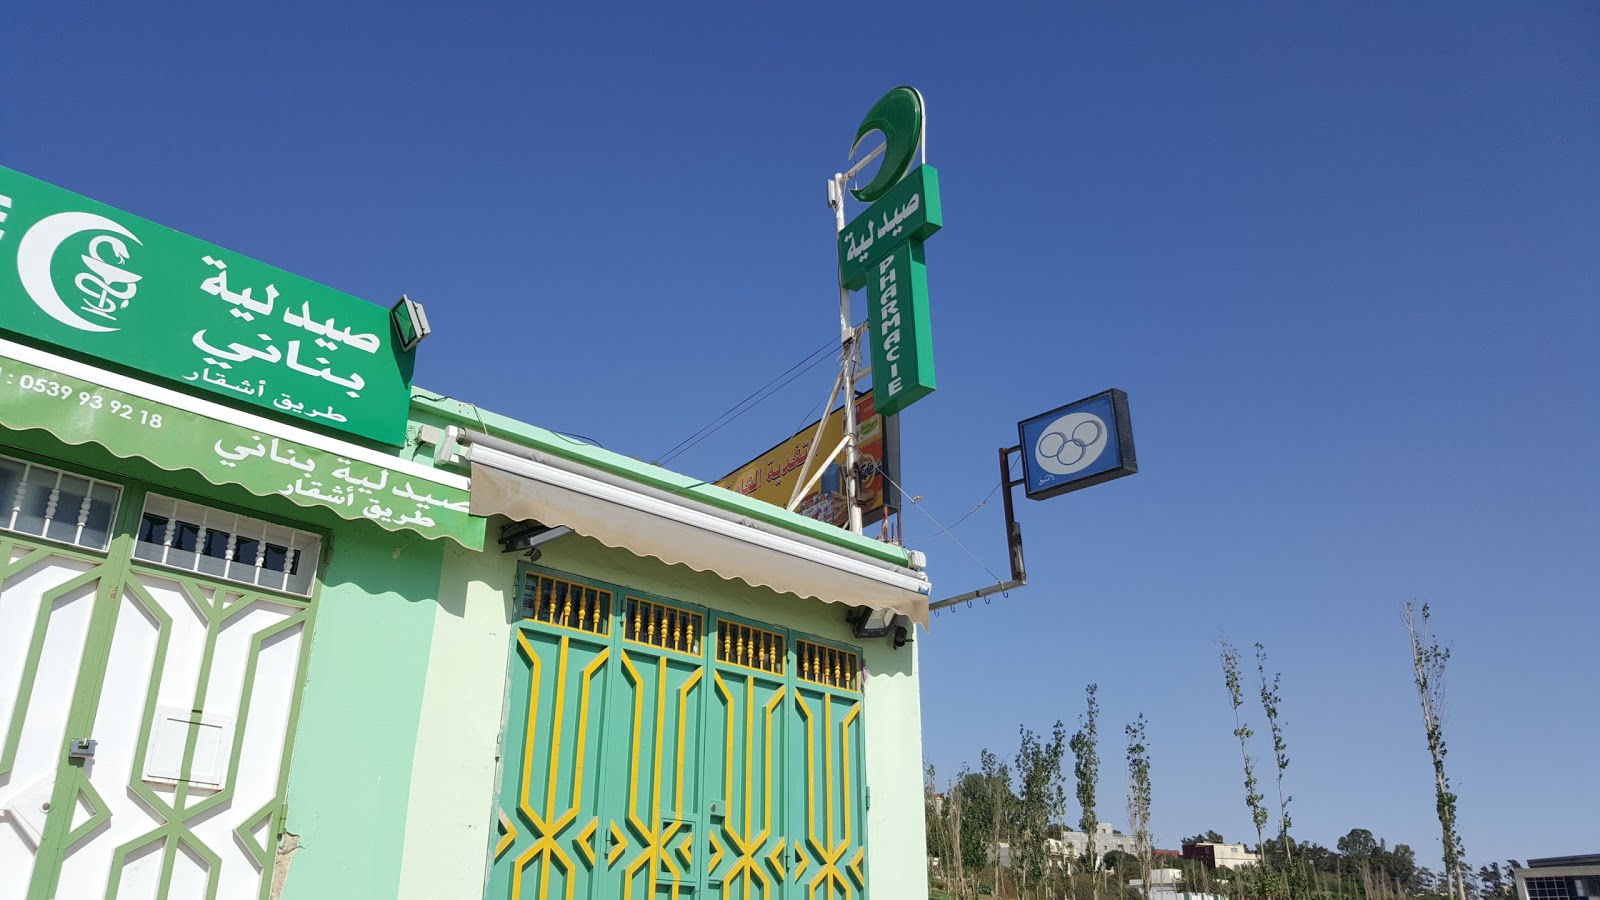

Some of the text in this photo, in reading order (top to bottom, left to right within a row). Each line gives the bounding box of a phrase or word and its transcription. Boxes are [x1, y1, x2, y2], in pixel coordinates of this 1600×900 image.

[843, 193, 919, 262] صيدلية
[200, 255, 381, 354] صيدلية
[879, 255, 903, 397] PHARMACIE
[192, 329, 366, 398] بناني
[19, 374, 73, 400] 0539
[79, 391, 103, 409] 93
[110, 400, 133, 420] 92
[140, 410, 163, 429] 18
[181, 368, 348, 422] طريق أشقار
[214, 435, 316, 478] بناني
[278, 478, 436, 528] طريق أشقار
